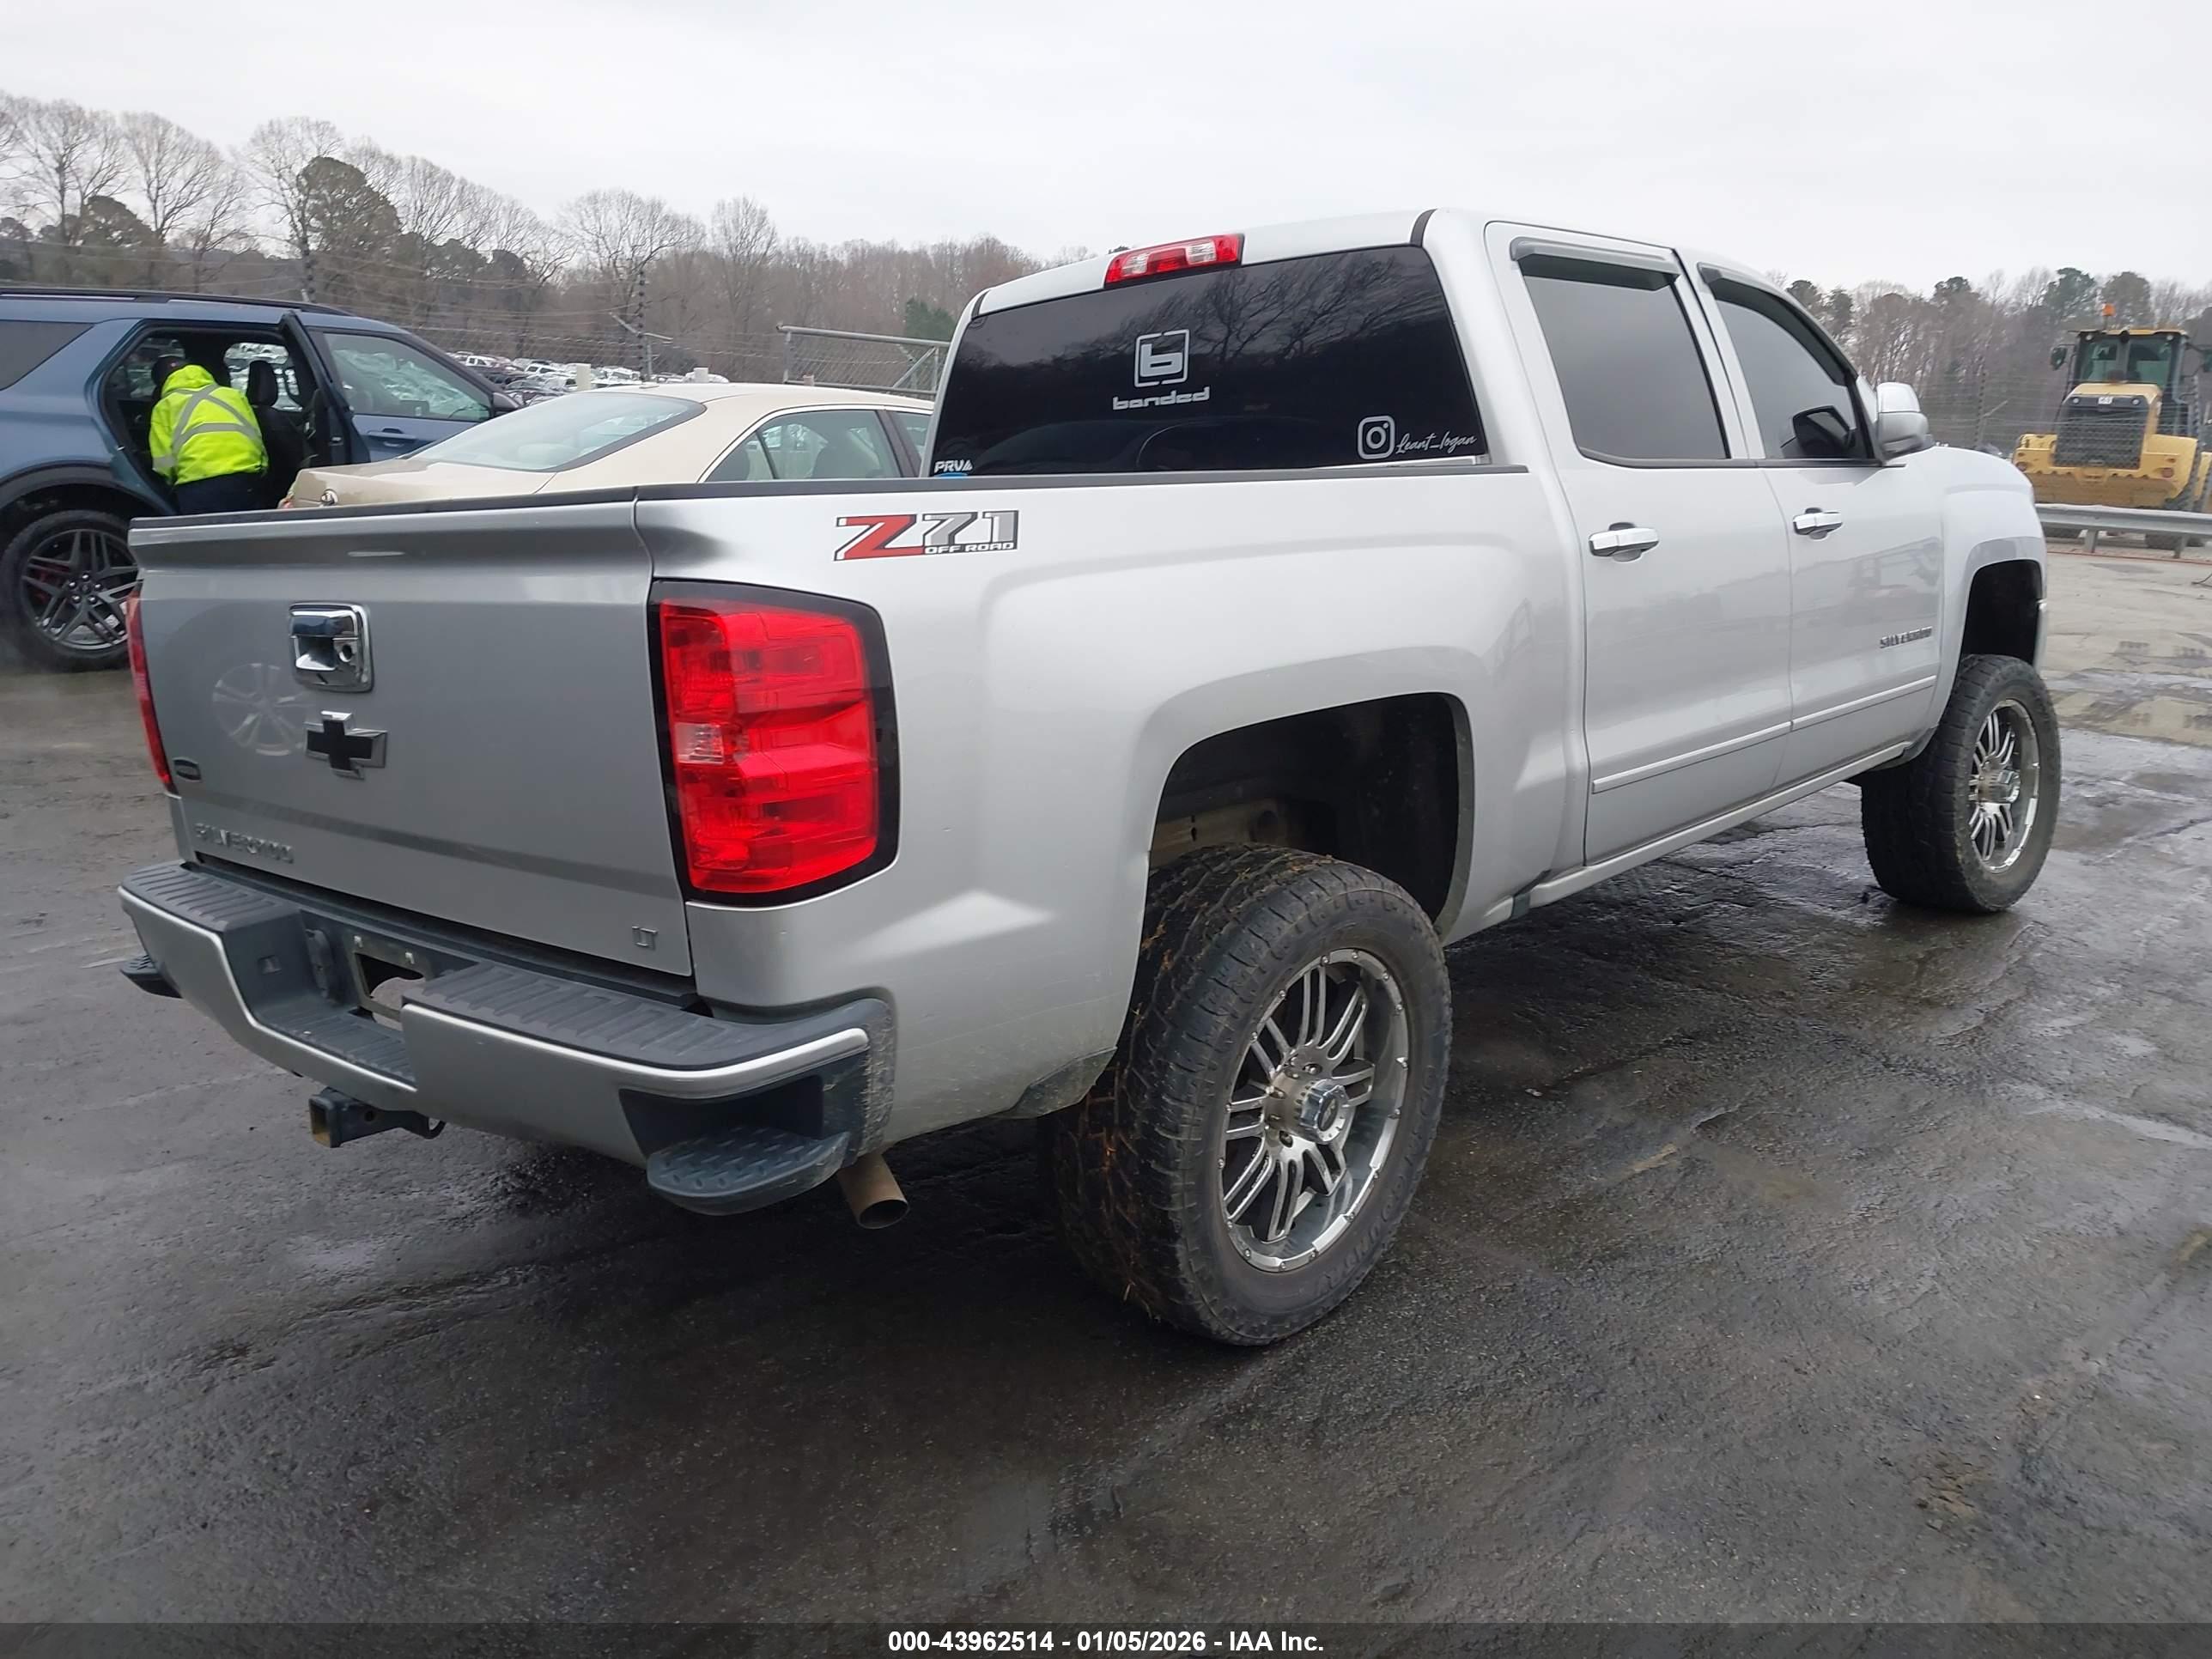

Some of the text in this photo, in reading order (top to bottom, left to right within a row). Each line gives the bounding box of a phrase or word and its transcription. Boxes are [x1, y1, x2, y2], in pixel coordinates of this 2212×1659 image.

[1112, 386, 1211, 410] banded
[834, 510, 1019, 561] Z71
[924, 542, 1015, 555] OFF ROAD
